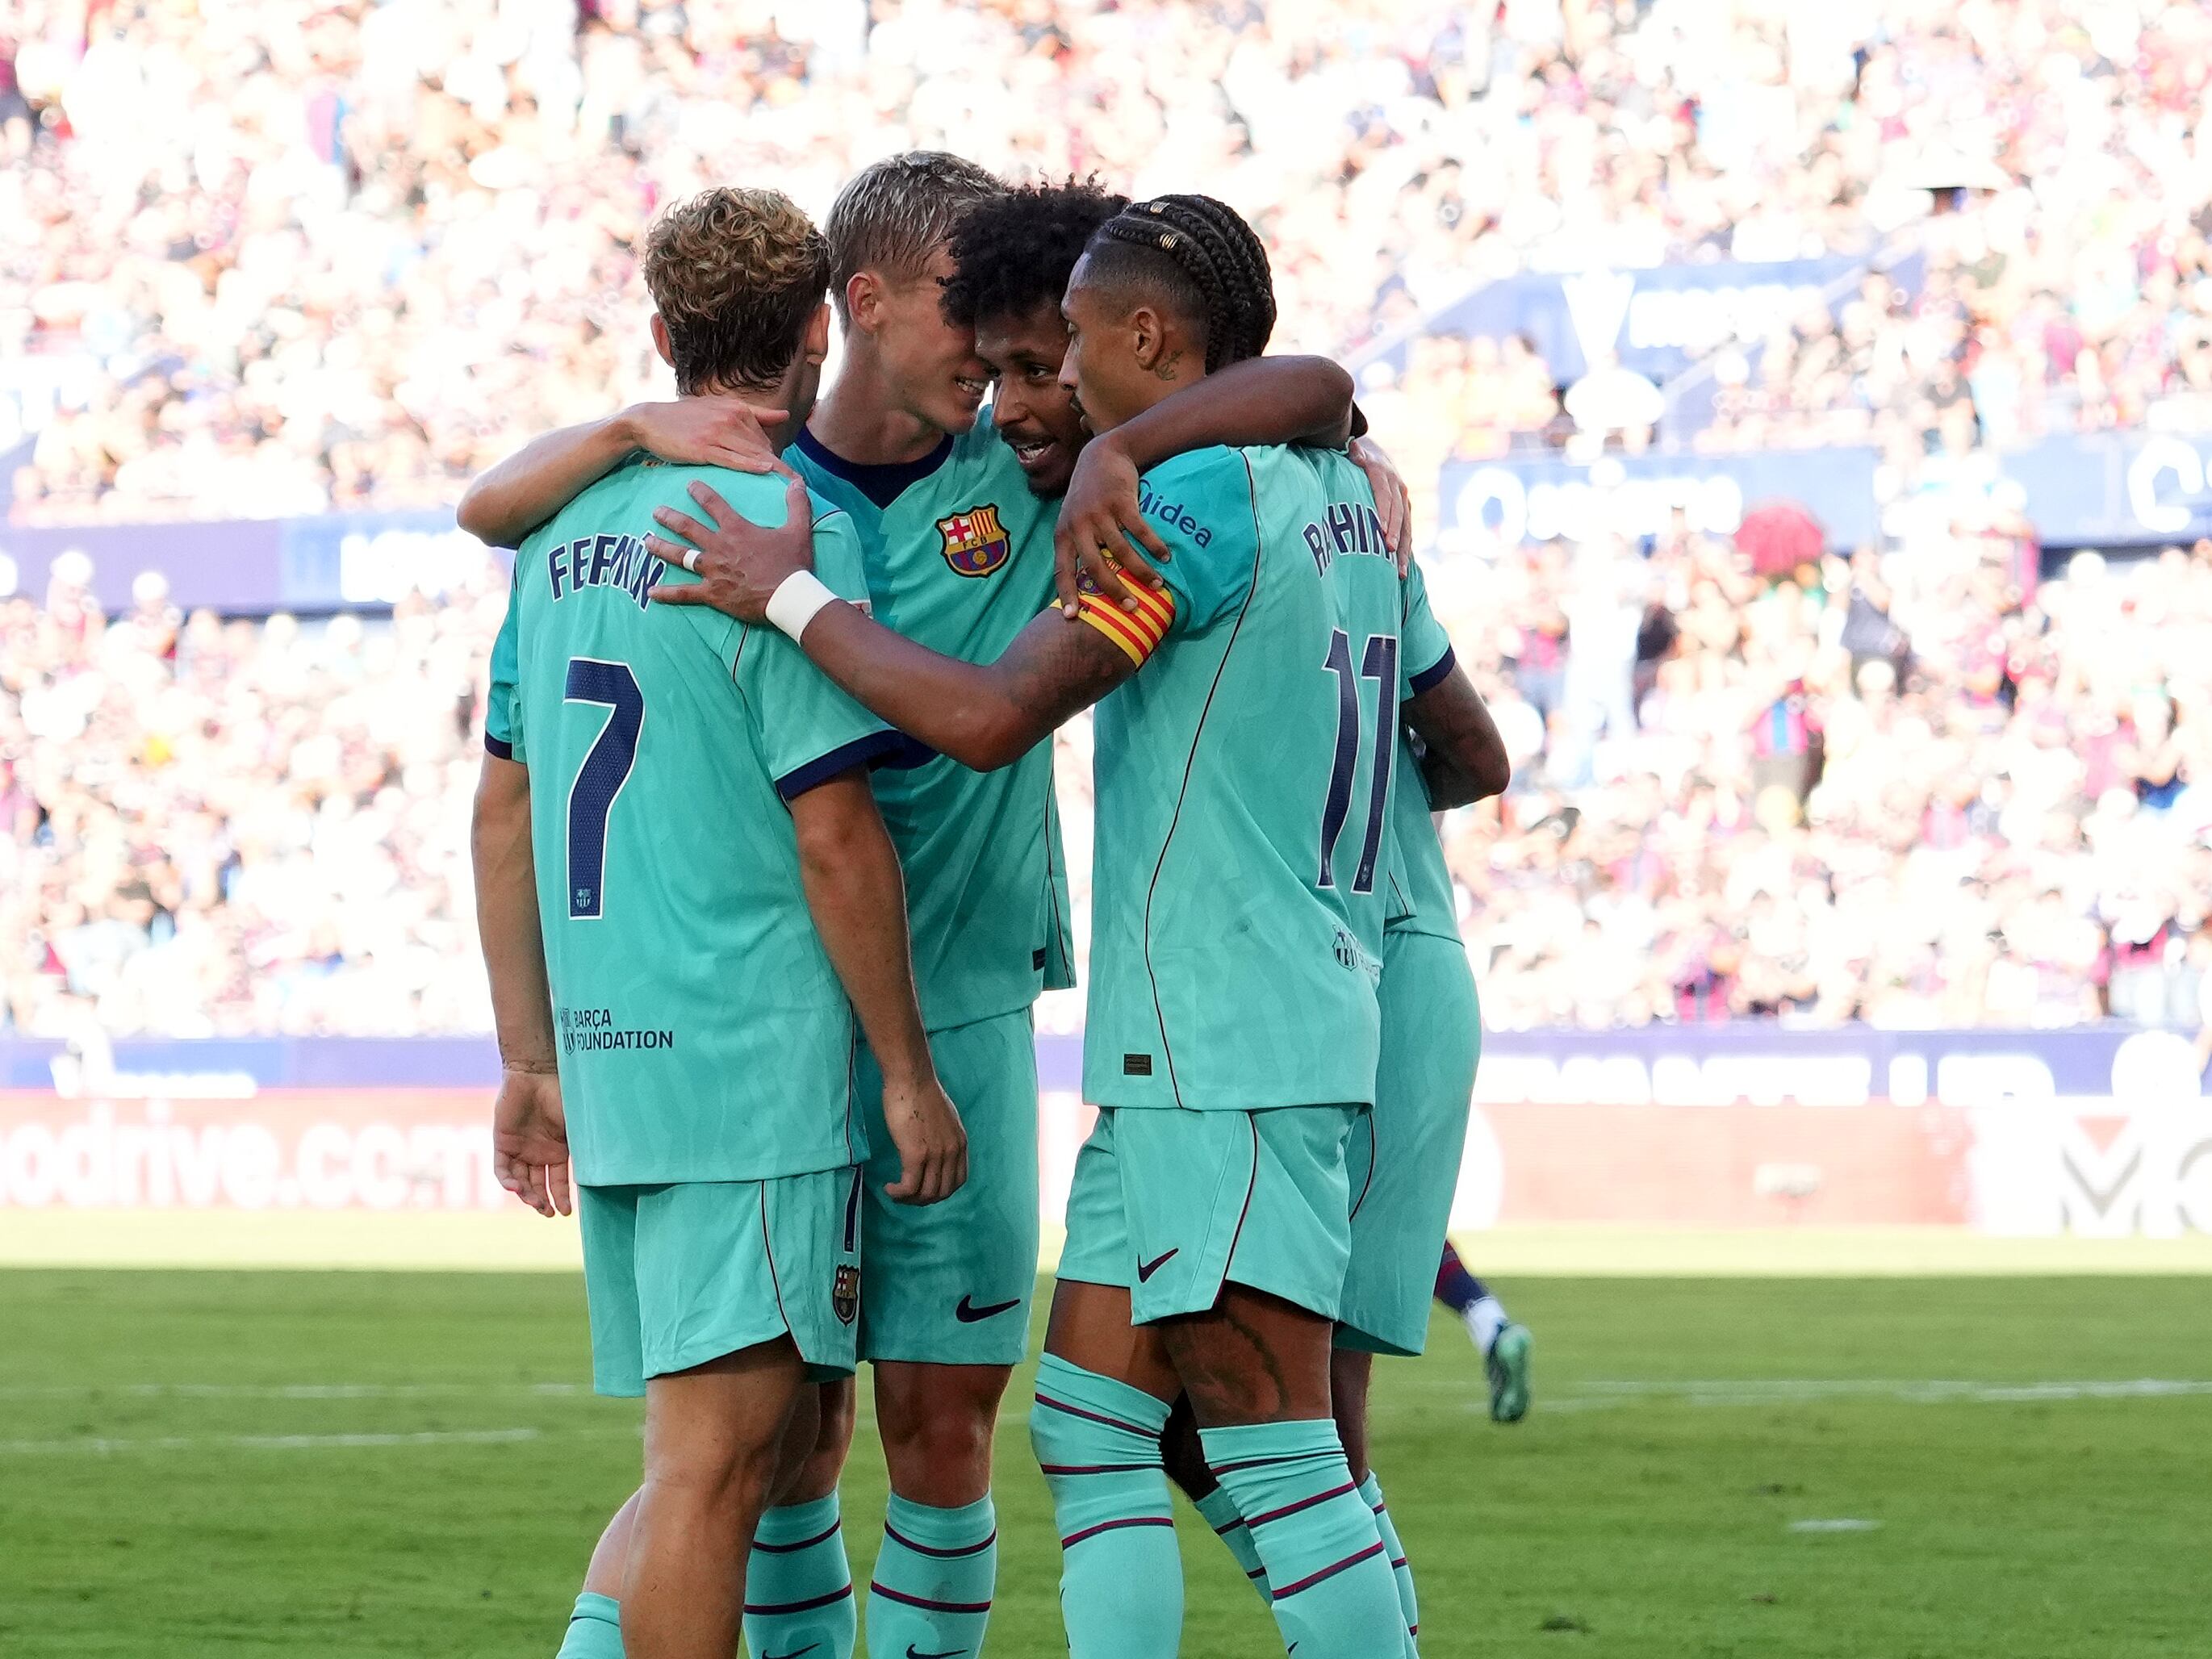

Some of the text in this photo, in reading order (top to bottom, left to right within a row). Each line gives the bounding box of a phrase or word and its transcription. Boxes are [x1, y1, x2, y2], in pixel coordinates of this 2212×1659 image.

[562, 656, 646, 920] 7
[1315, 626, 1397, 894] 11
[574, 1009, 612, 1030] BARÇA
[577, 1030, 674, 1051] FOUNDATION
[0, 1099, 504, 1208] odrive.com
